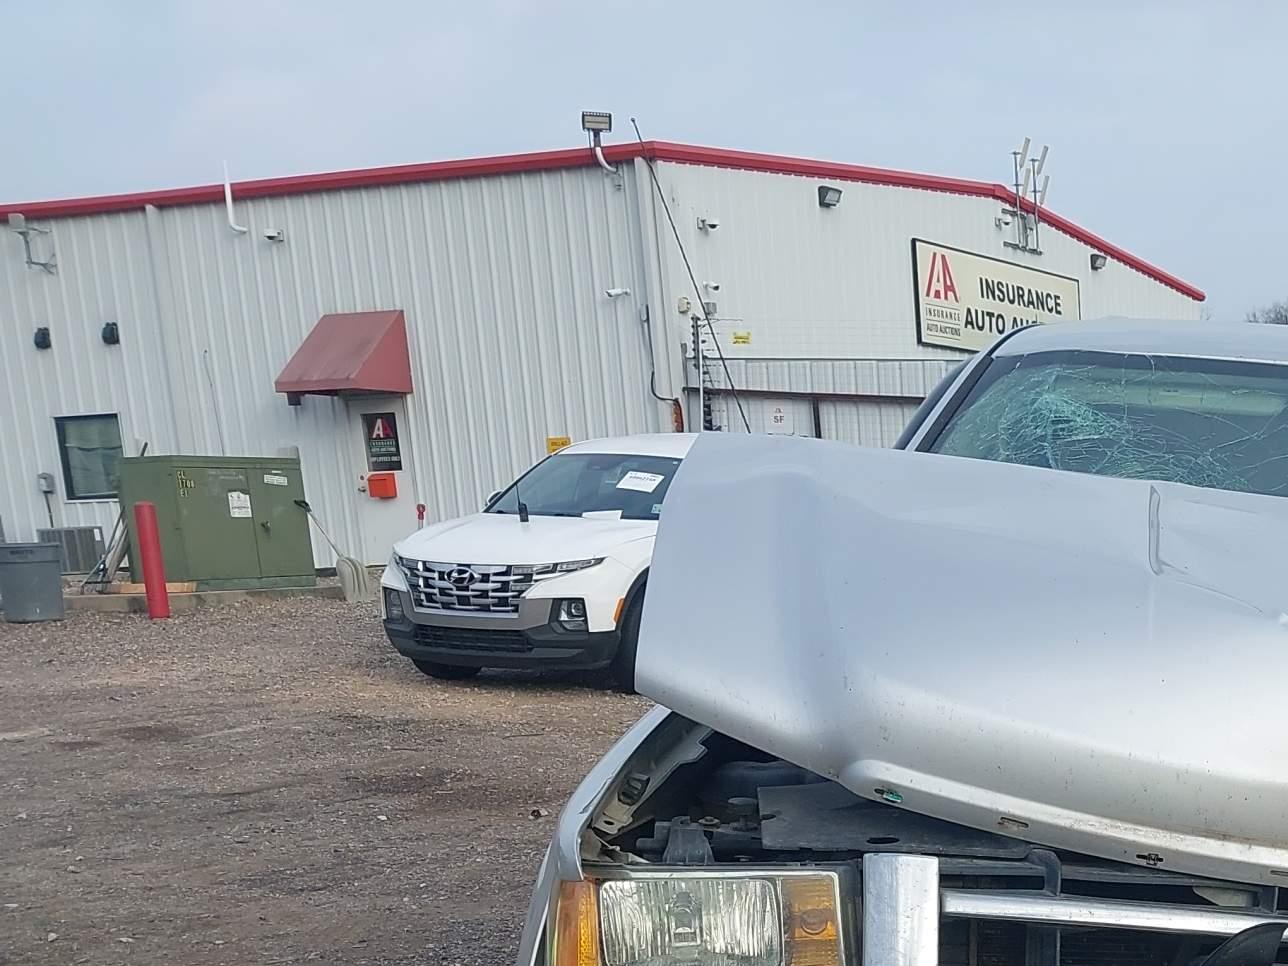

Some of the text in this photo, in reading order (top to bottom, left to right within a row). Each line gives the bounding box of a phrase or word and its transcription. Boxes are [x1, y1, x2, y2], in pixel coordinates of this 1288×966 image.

[979, 277, 1062, 315] INSURANCE
[926, 307, 960, 321] INSURANCE
[964, 307, 1006, 334] AUTO
[927, 323, 961, 336] AUTO AUCTIONS
[773, 415, 785, 423] SF
